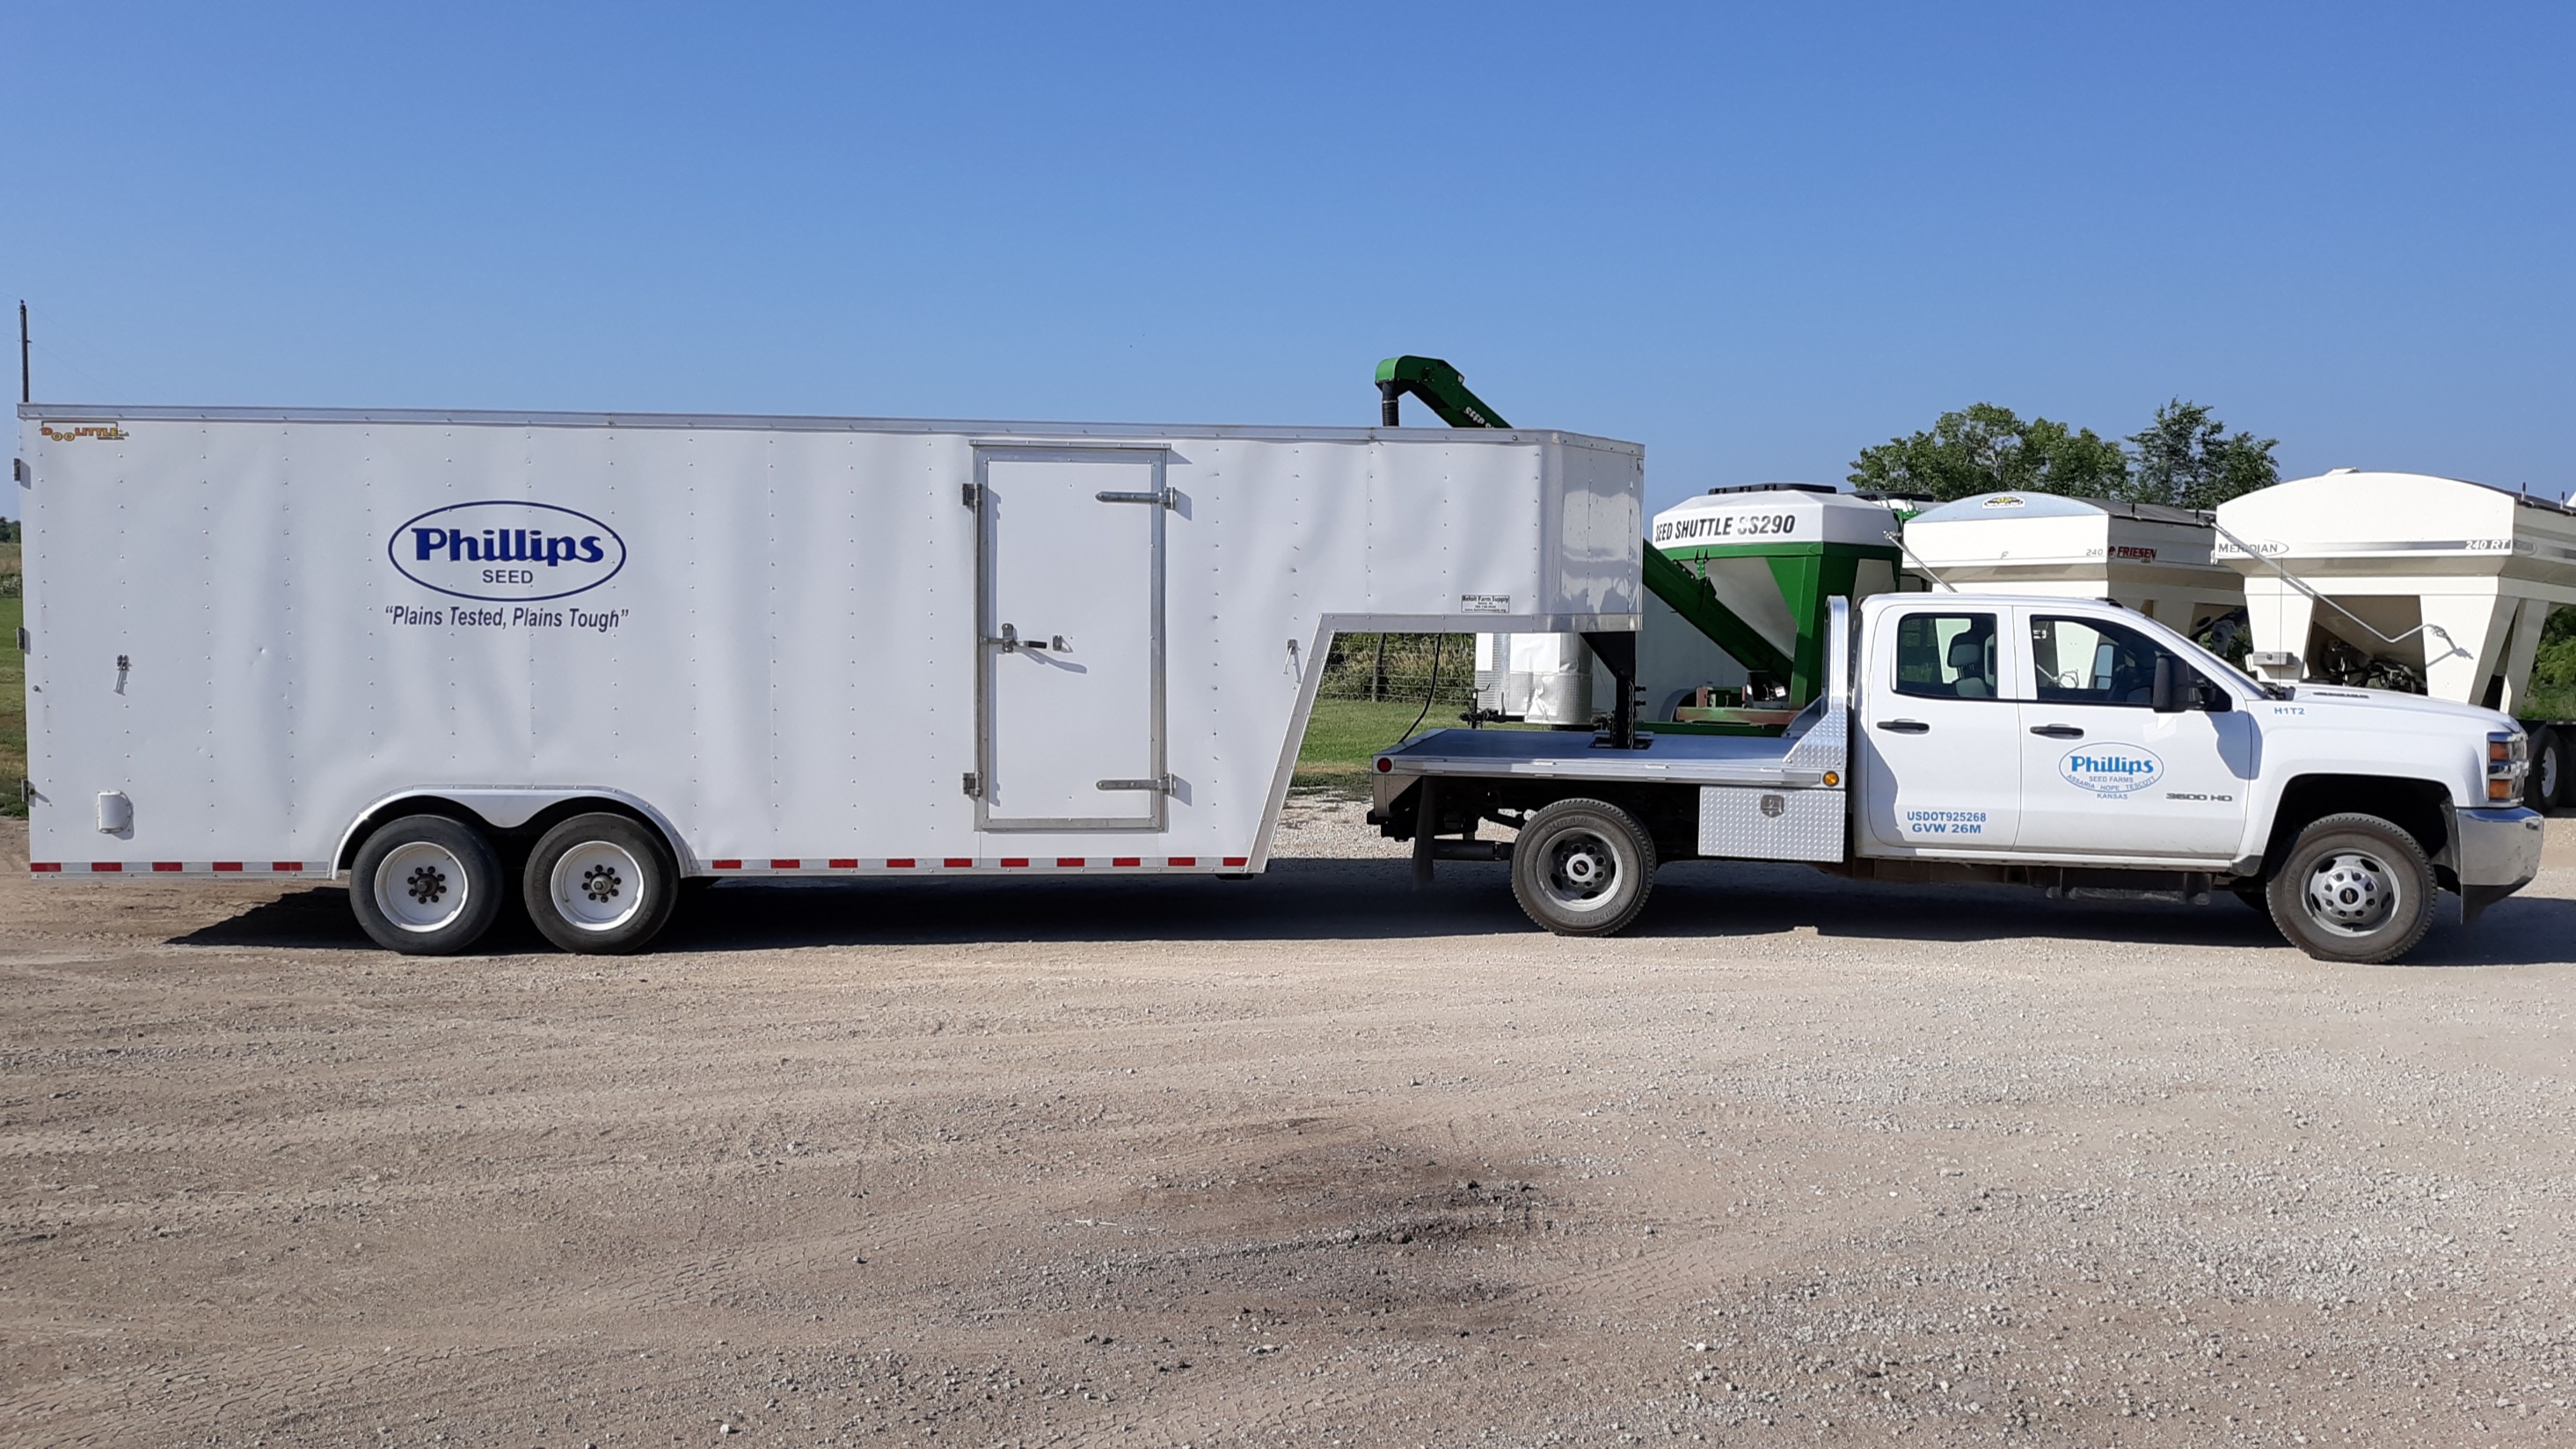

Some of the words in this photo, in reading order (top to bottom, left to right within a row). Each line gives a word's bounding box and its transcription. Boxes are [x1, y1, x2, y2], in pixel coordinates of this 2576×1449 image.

[40, 428, 119, 442] DOOLITTLE
[1655, 523, 1672, 543] SEED
[1675, 517, 1733, 539] SHUTTLE
[1737, 515, 1796, 536] SS290
[411, 528, 604, 567] Phillips
[2465, 539, 2488, 550] 240
[2490, 539, 2507, 549] RT
[2117, 546, 2156, 560] FRIESEN
[482, 570, 534, 584] SEED
[450, 606, 507, 629] Tested,
[513, 607, 563, 627] Plains
[2069, 756, 2154, 775] Phillips
[2066, 774, 2095, 789] ASSARIA
[2125, 776, 2156, 790] TESCOTT
[1907, 811, 1987, 823] USDOT925268
[1911, 823, 1946, 833] GVW
[1951, 824, 1981, 834] 26M
